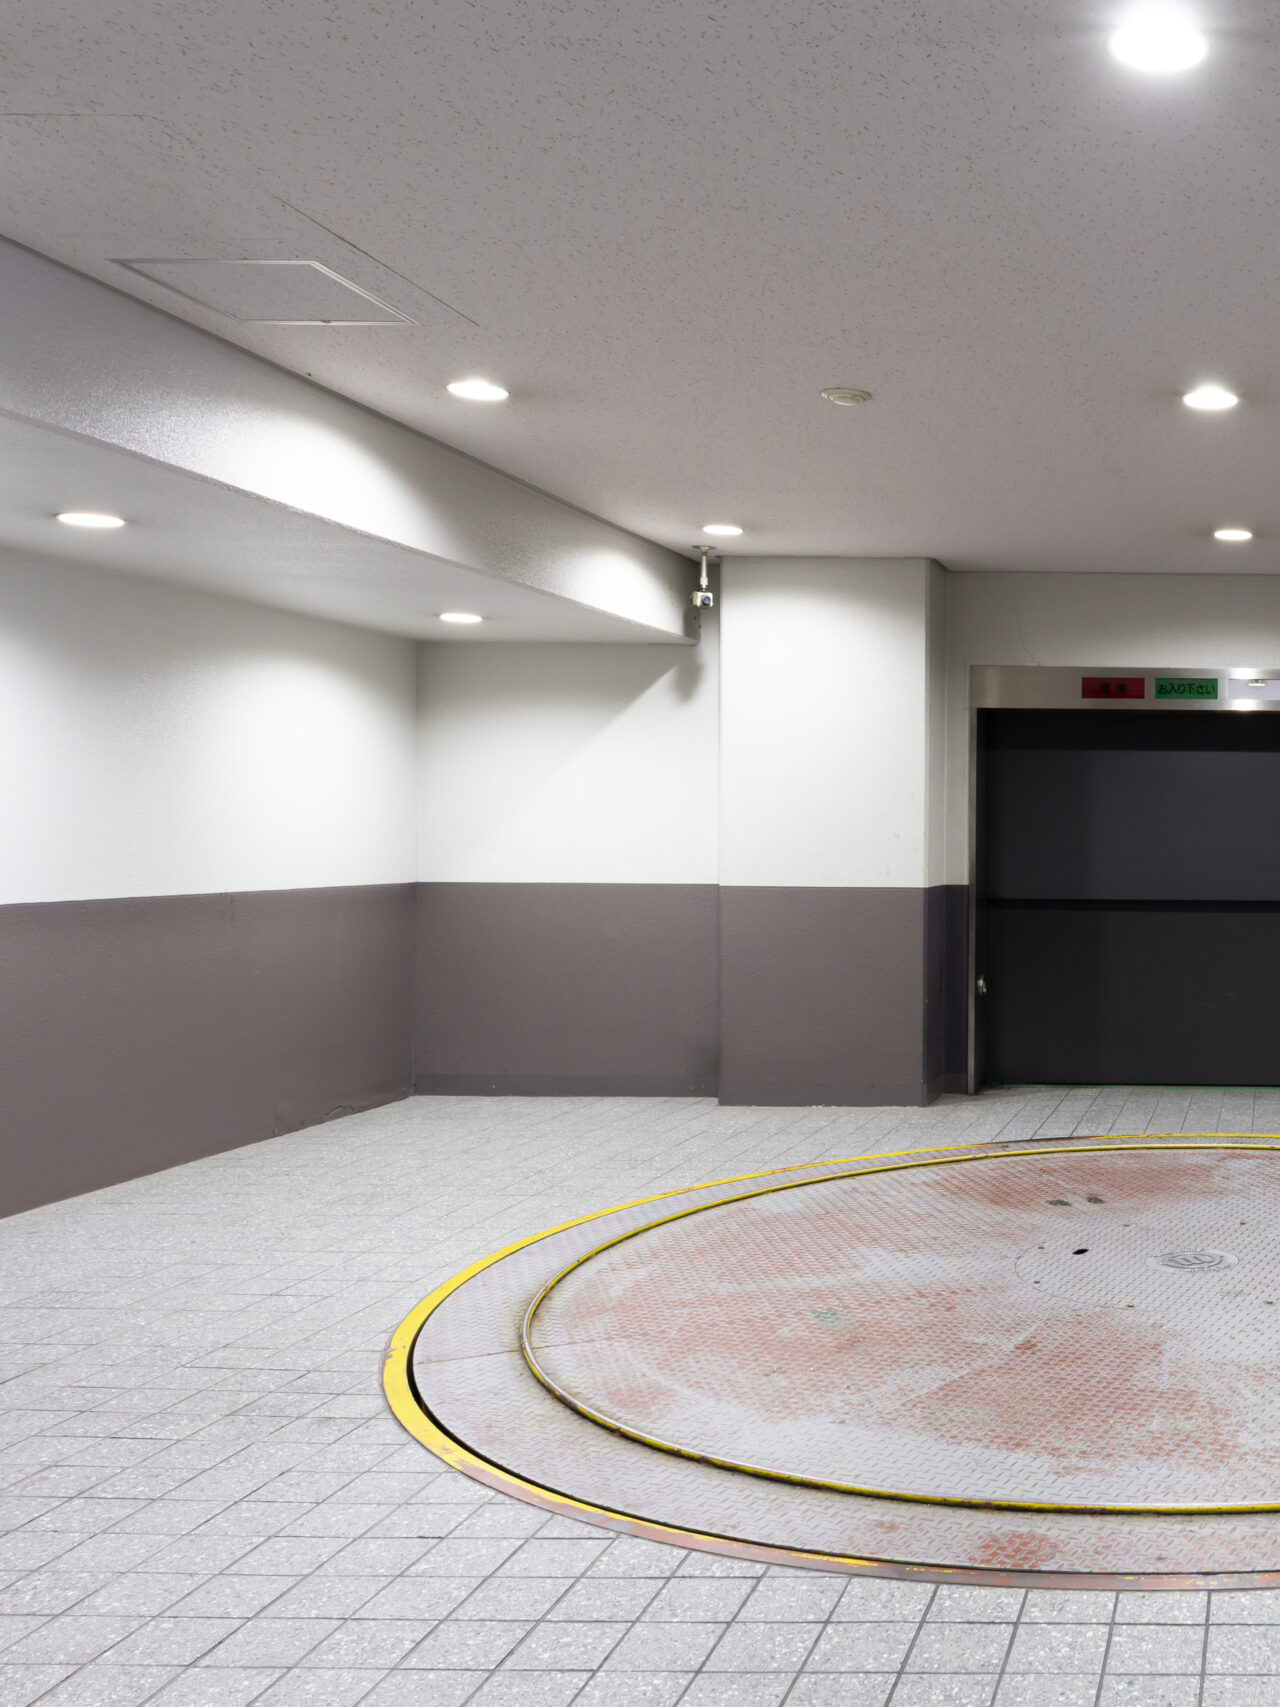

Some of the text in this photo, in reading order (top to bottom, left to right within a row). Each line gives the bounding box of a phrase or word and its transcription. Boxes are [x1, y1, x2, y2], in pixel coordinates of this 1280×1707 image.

[1158, 683, 1216, 695] お入り下さい
